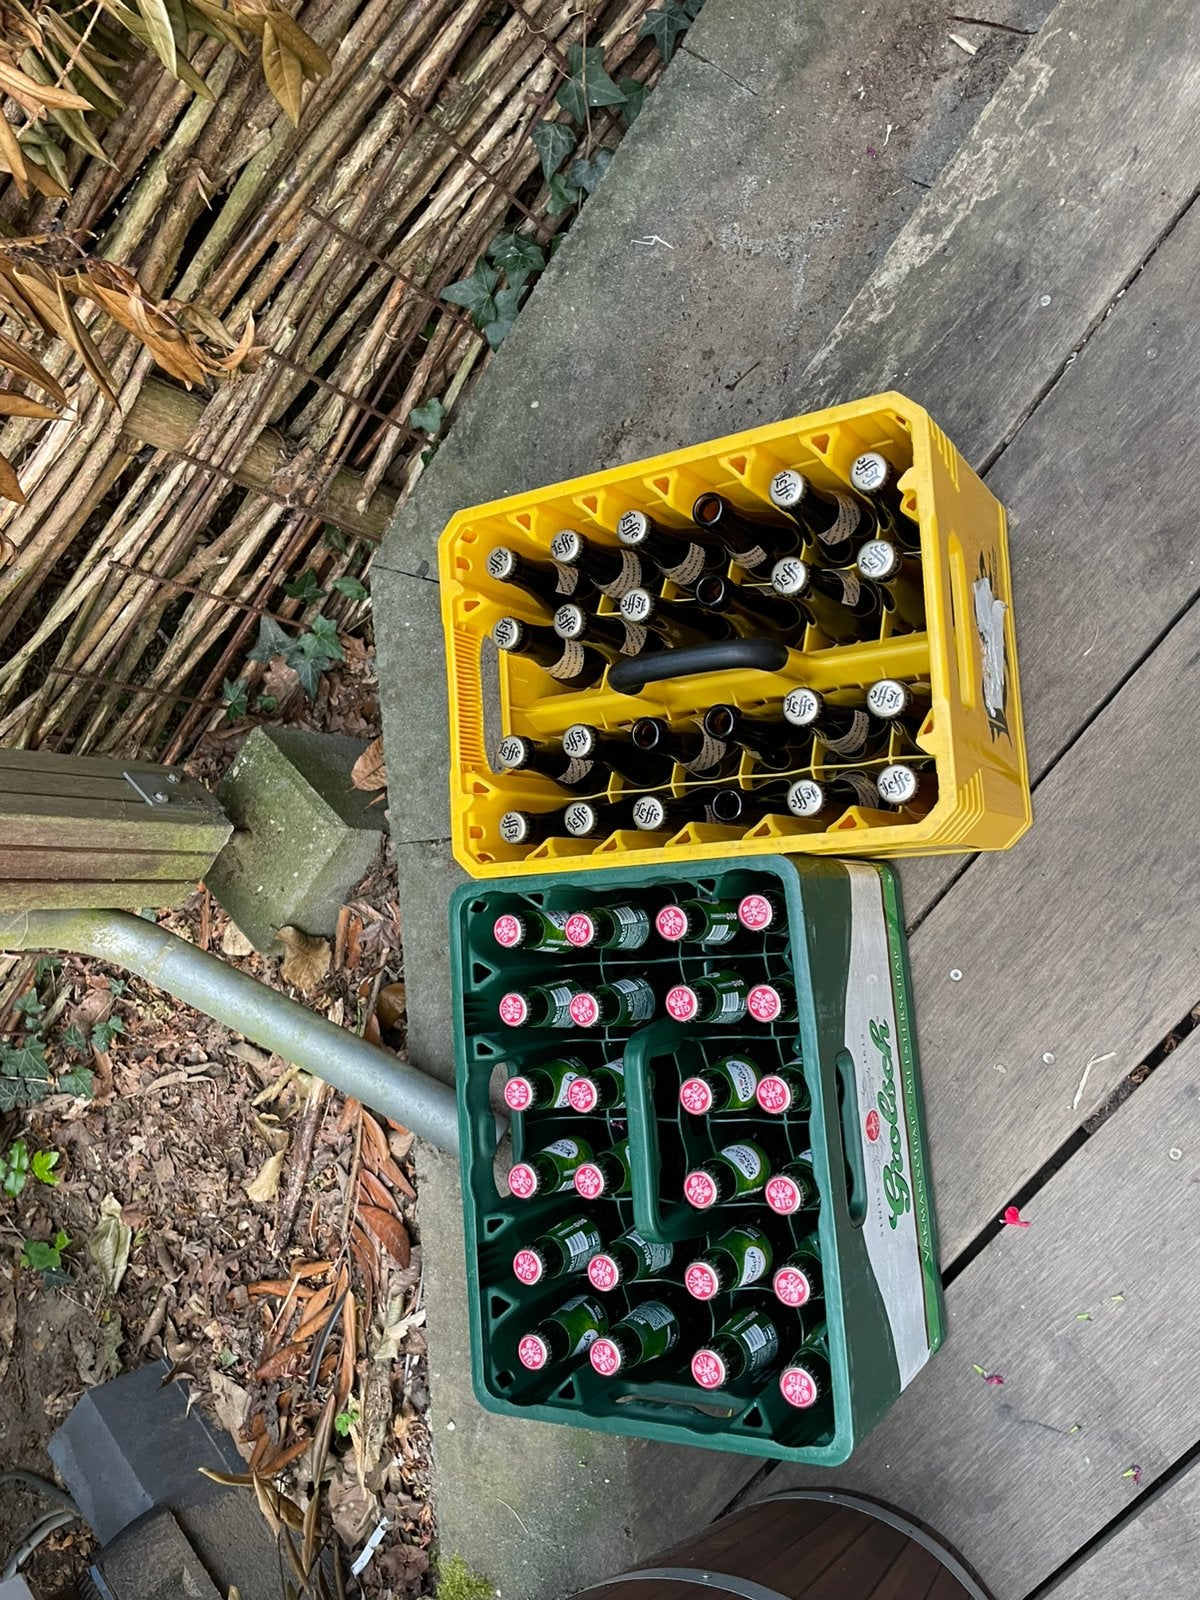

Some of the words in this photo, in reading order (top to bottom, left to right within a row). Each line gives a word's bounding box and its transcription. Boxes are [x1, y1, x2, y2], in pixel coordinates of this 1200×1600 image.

[856, 459, 879, 486] Leffe
[773, 472, 793, 500] Leffe
[620, 512, 639, 538] Leffe
[551, 534, 574, 555] Leffe
[489, 548, 508, 575] Leffe
[861, 544, 888, 573] Leffe
[774, 561, 801, 591] Leffe
[622, 594, 646, 615] Leffe
[496, 618, 513, 645] Leffe
[557, 606, 575, 632] Leffe
[786, 696, 815, 717] Leffe
[870, 685, 901, 708] Leffe
[499, 741, 520, 761] Leffe
[565, 729, 588, 751] Leffe
[880, 770, 911, 797] Leffe
[791, 785, 820, 809] Leffe
[566, 806, 588, 832] Leffe
[635, 802, 660, 824] Leffe
[502, 814, 518, 841] Leffe
[868, 1018, 911, 1231] Grolsch
